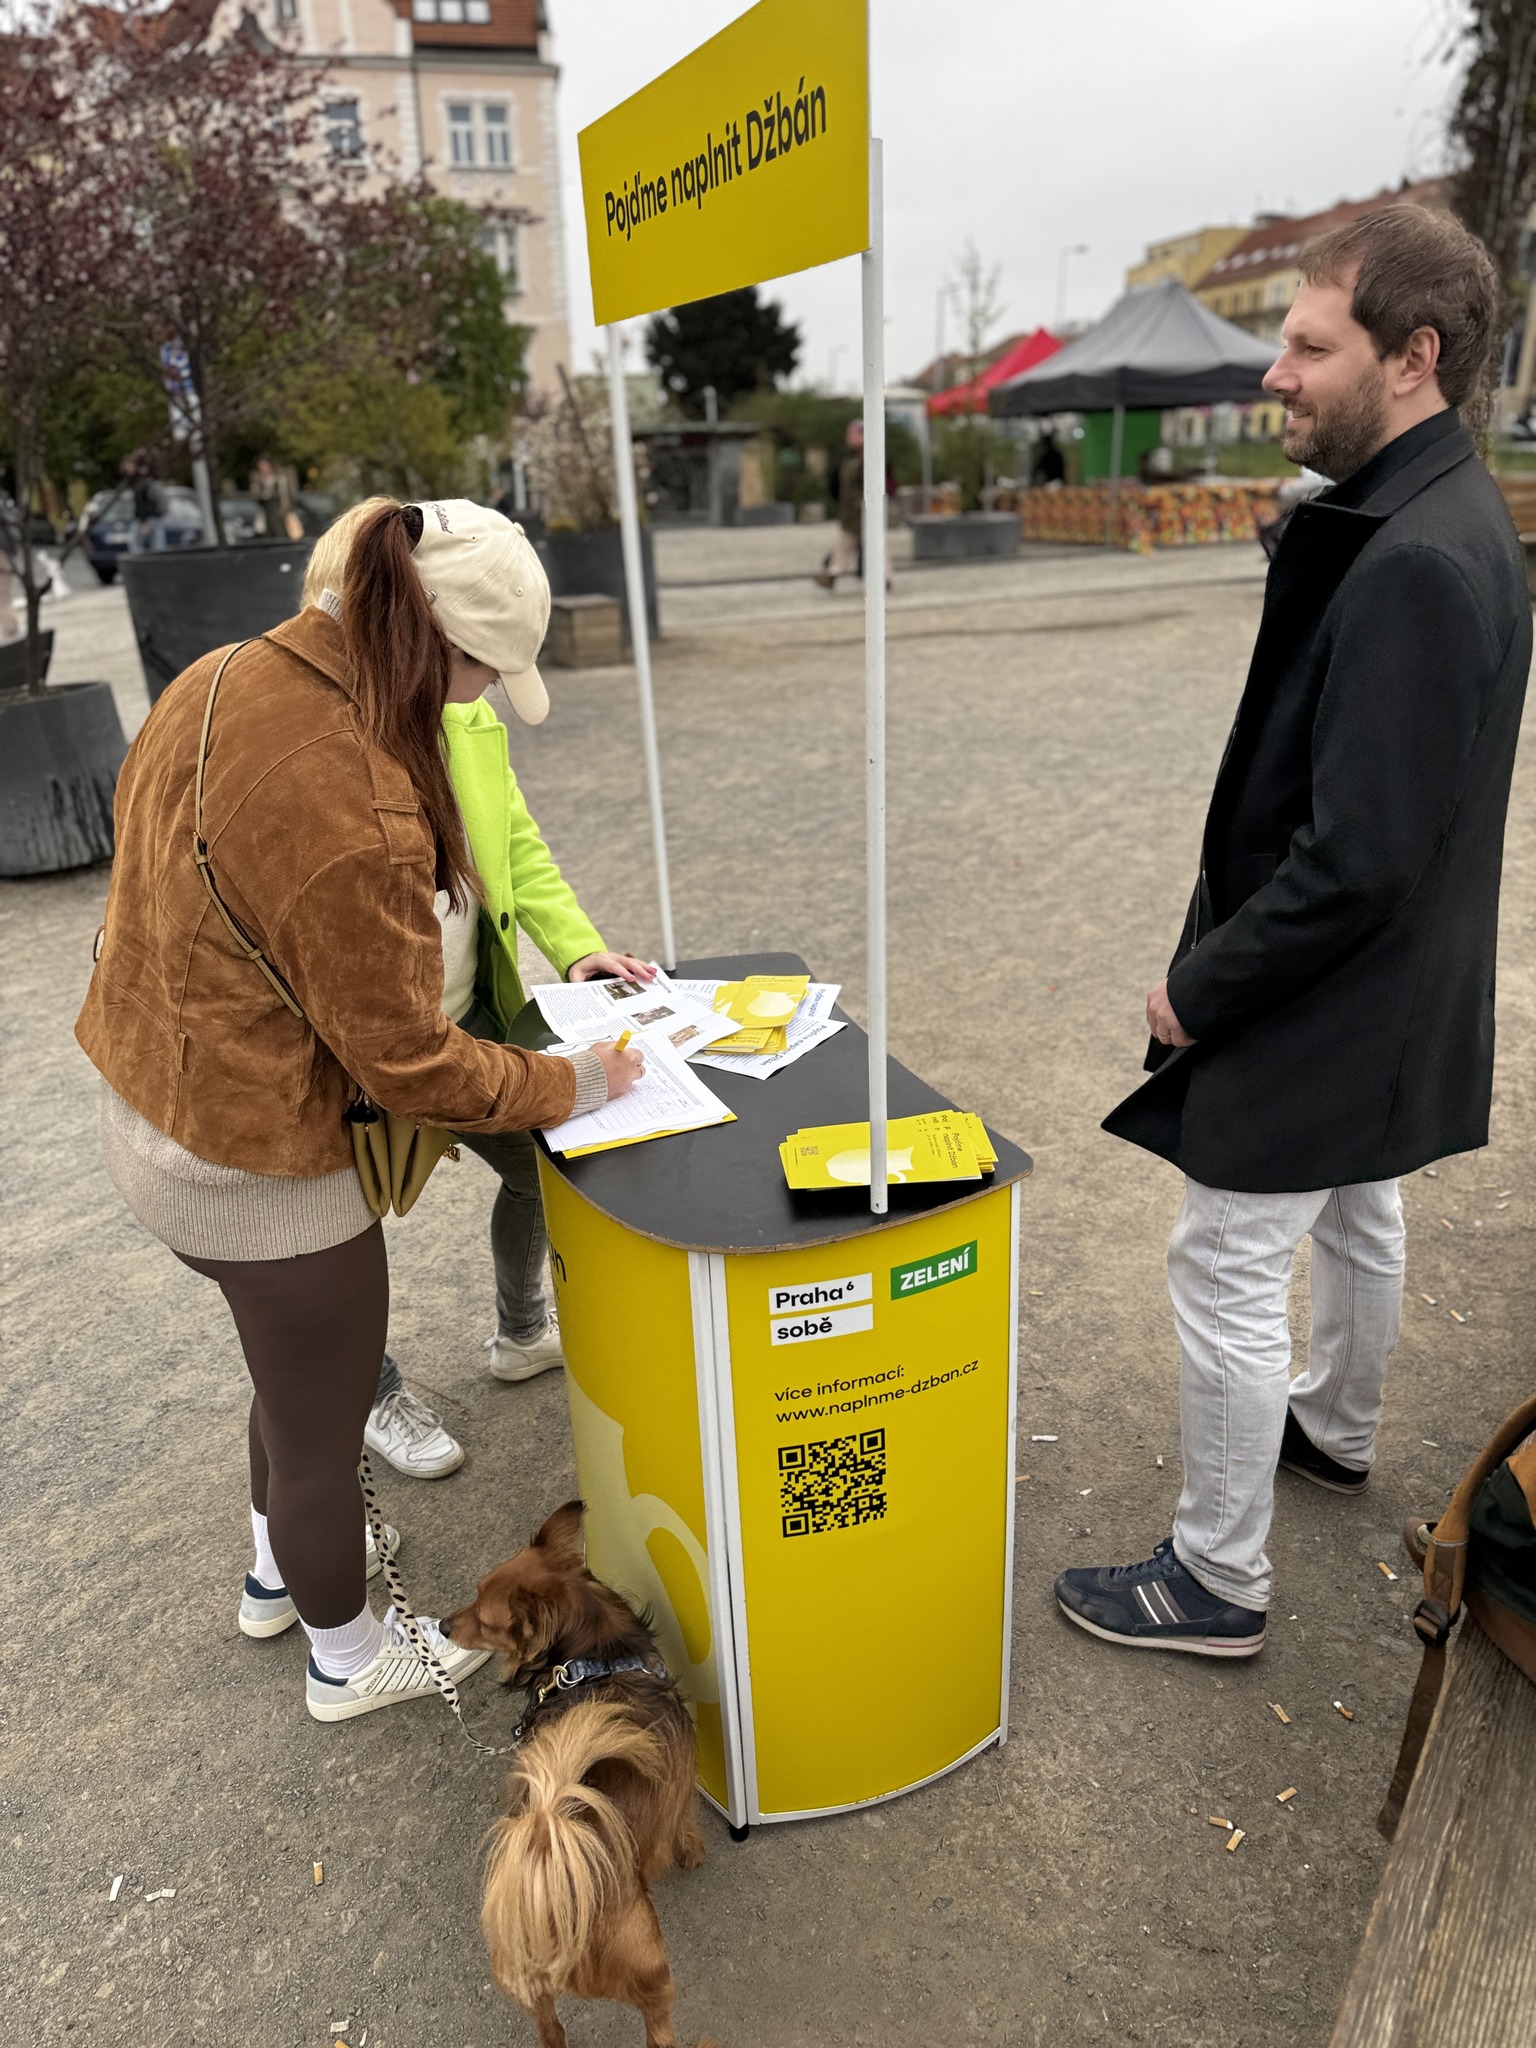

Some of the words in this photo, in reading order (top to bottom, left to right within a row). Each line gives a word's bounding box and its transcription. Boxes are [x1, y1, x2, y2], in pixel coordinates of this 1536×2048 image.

[604, 170, 668, 242] Pojďme
[670, 120, 743, 211] naplnit
[745, 75, 827, 172] Džbán
[900, 1246, 971, 1292] ZELENÍ
[777, 1316, 833, 1340] sobě
[774, 1384, 813, 1402] více
[817, 1364, 905, 1396] informací:
[775, 1359, 980, 1423] www.naplnme-dzban.cz
